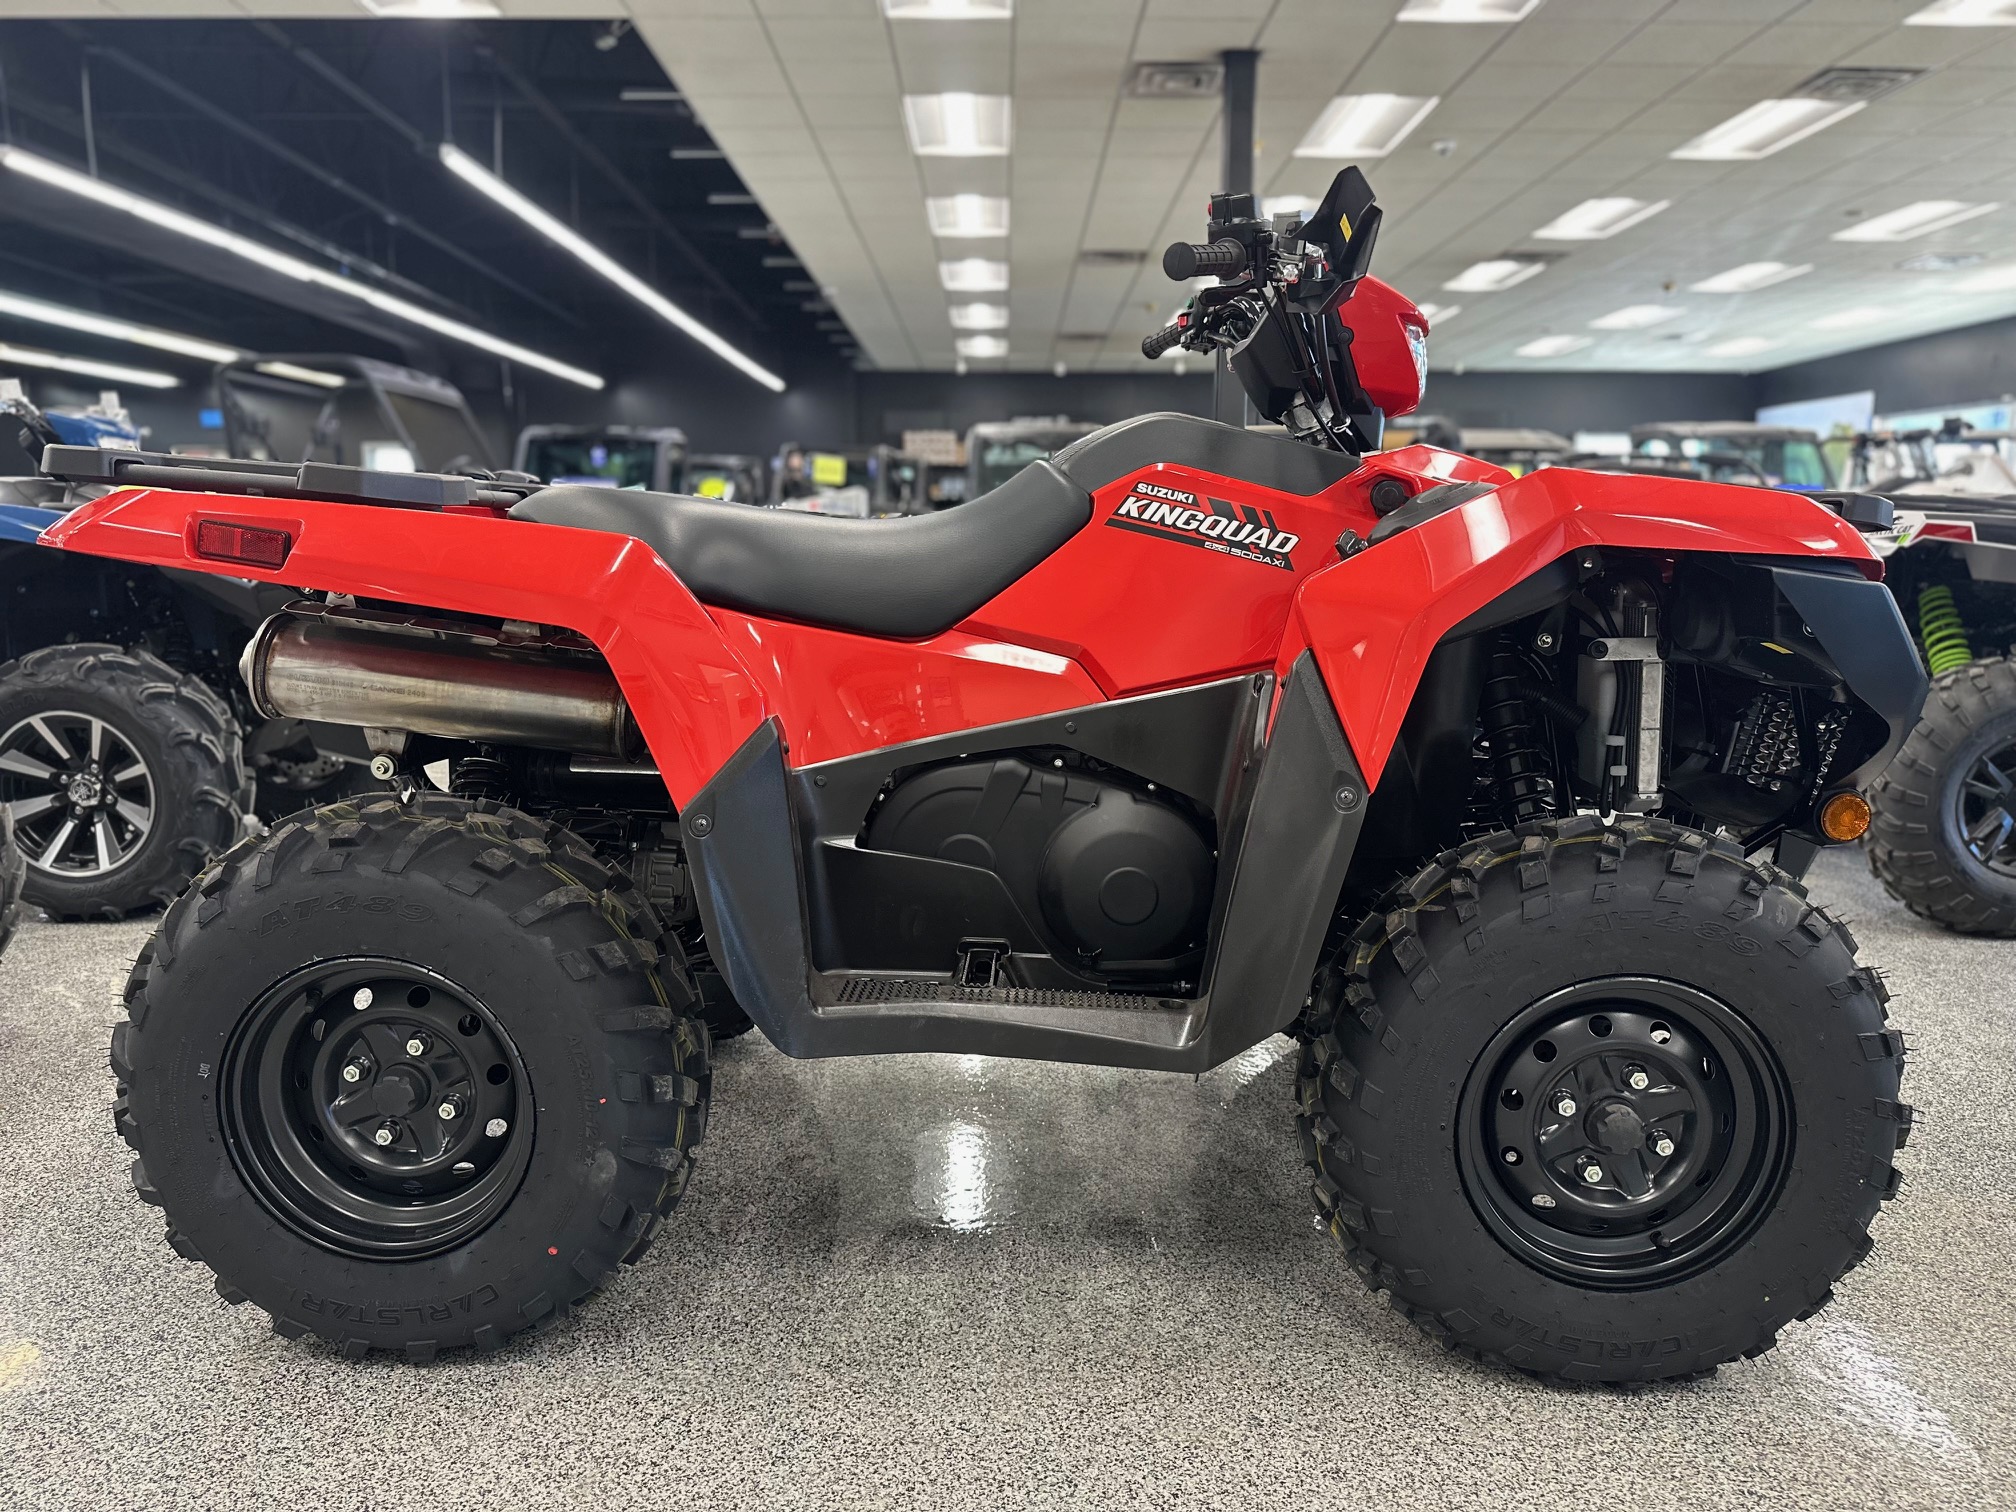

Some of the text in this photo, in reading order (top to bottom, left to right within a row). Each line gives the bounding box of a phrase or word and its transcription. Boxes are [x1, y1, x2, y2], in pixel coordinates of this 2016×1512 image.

[1136, 483, 1194, 504] SUZUKI
[1117, 496, 1301, 554] KINGQUAD
[260, 894, 434, 938] AT489
[1575, 909, 1765, 957] AT489
[301, 1282, 500, 1328] CARLSTAR
[1489, 1305, 1682, 1363] CARLSTAR
